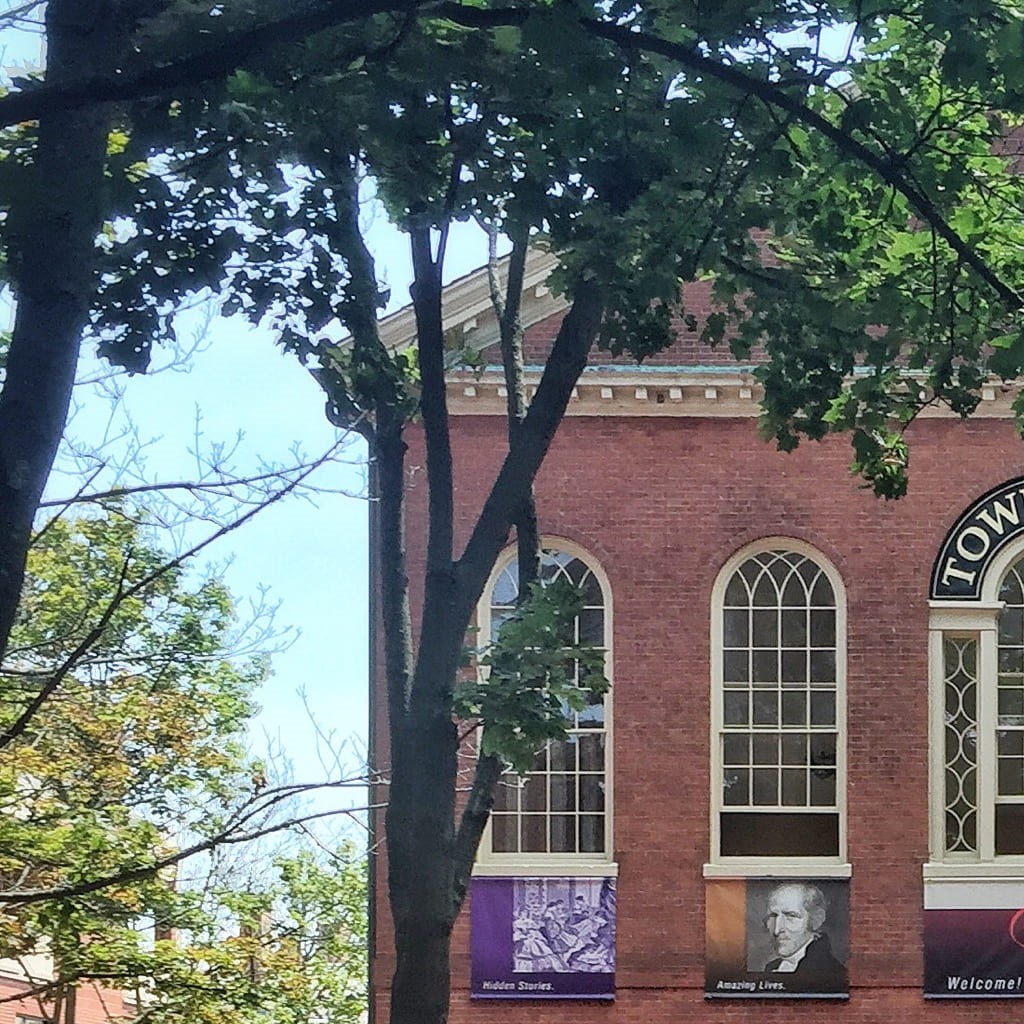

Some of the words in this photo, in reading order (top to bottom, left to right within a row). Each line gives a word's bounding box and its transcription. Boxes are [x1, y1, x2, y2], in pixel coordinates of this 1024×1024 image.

[482, 980, 516, 991] Hidden
[716, 980, 757, 992] Amazing
[947, 976, 1022, 991] Welcome!
